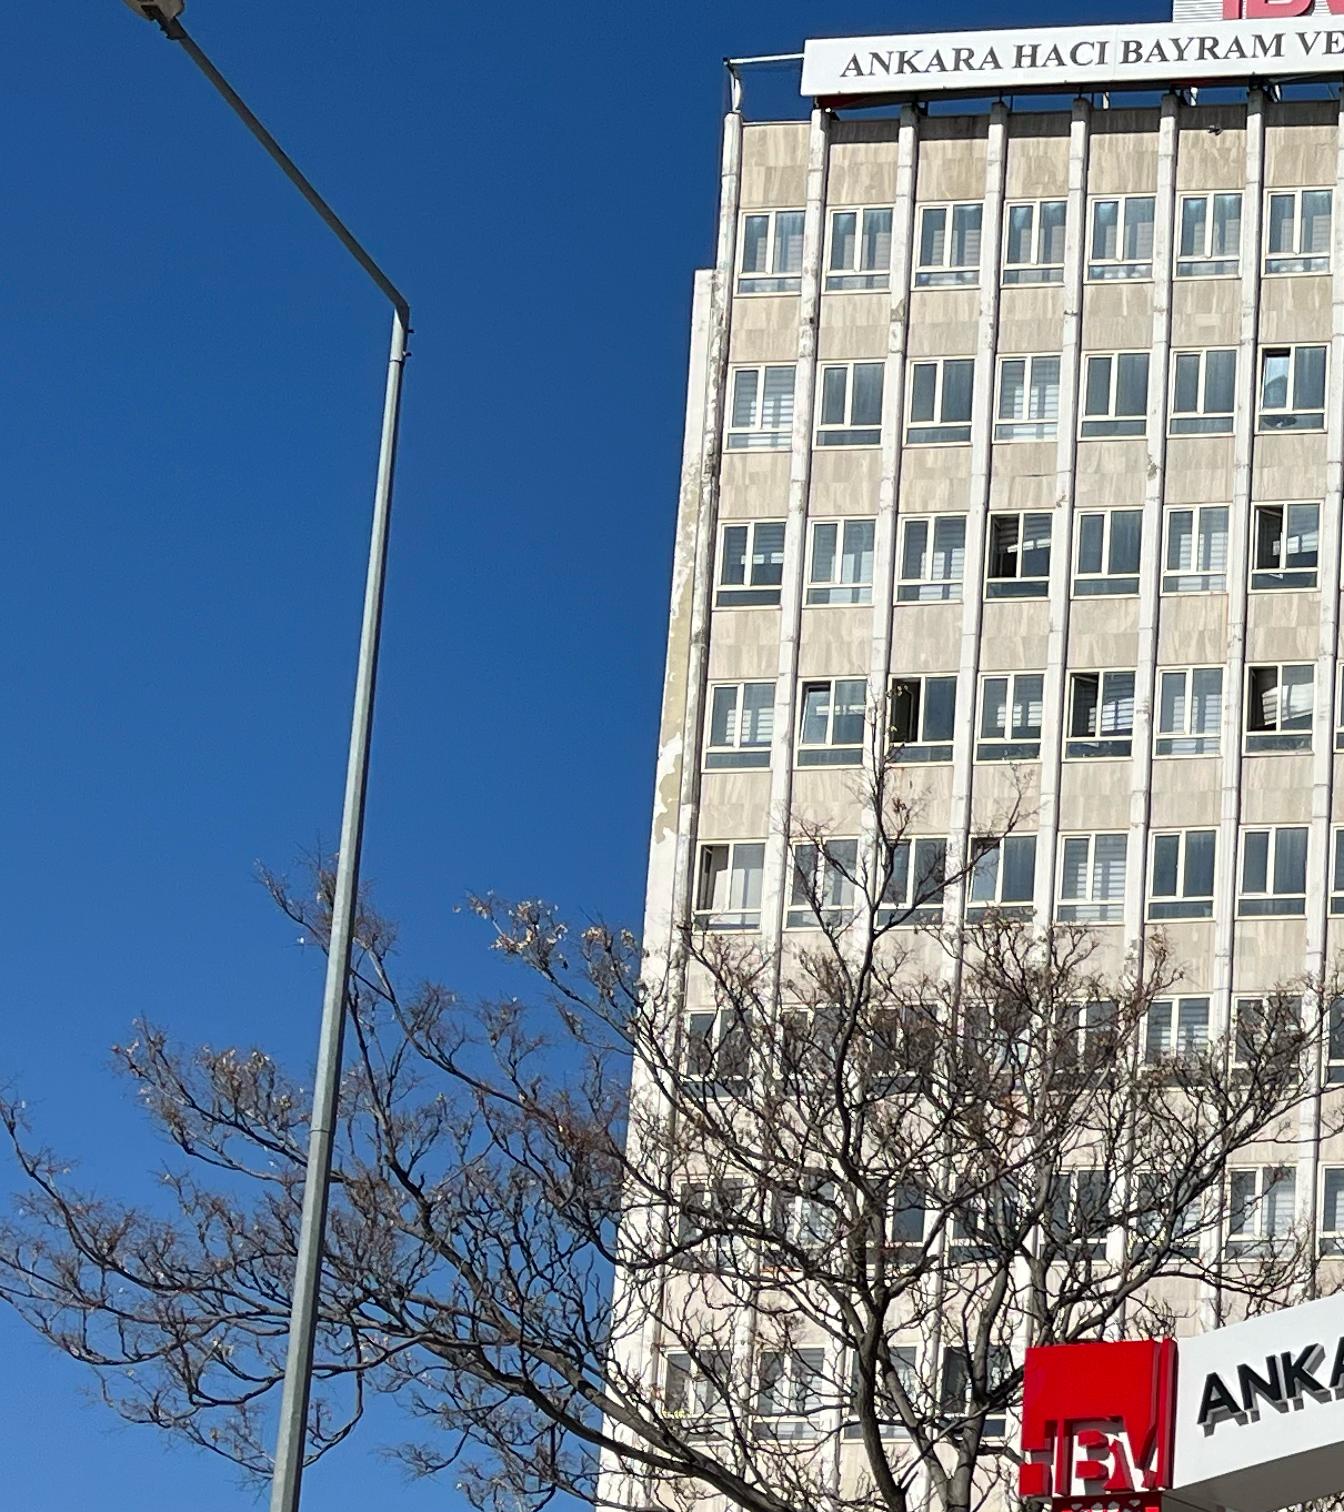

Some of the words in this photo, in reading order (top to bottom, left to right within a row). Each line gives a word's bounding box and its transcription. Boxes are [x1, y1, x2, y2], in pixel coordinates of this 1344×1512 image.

[840, 46, 1002, 78] ANKARA
[1013, 40, 1111, 69] HACI
[1119, 33, 1286, 65] BAYRAM
